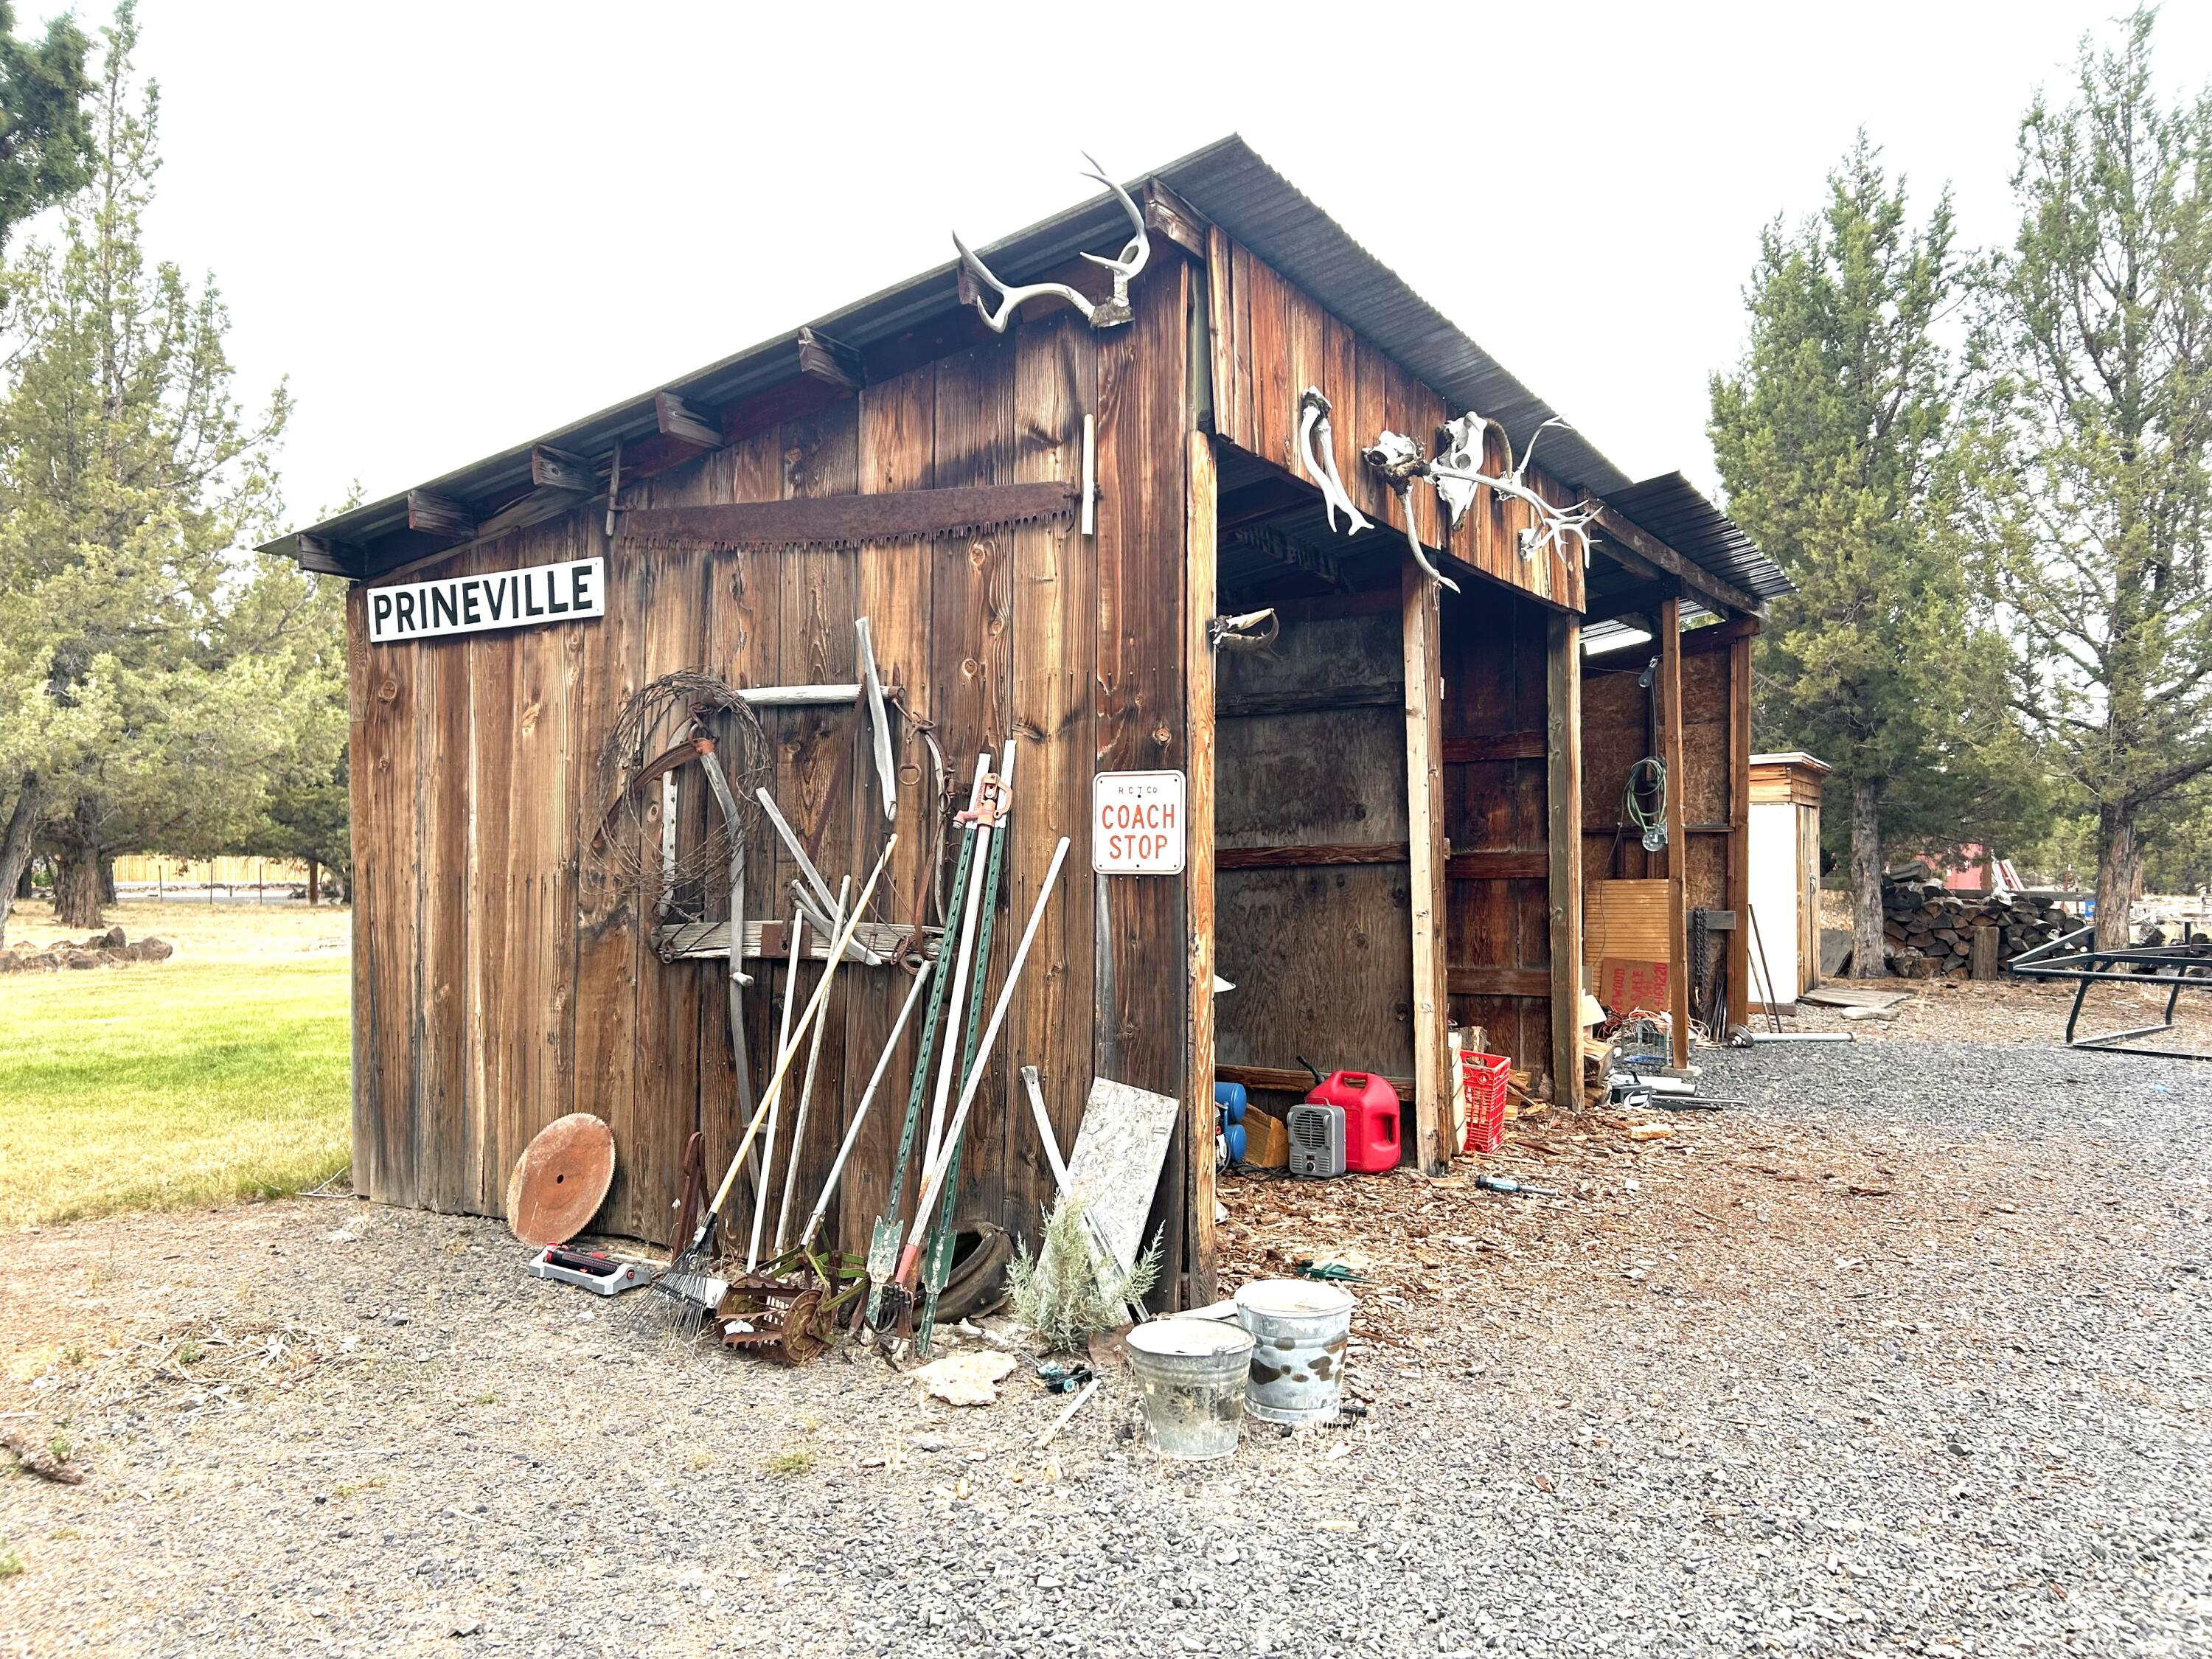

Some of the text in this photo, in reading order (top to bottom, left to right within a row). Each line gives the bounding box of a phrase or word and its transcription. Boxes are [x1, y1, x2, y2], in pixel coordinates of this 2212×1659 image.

[374, 565, 593, 635] PRINEVILLE
[1102, 804, 1175, 830] COACH
[1109, 835, 1168, 860] STOP
